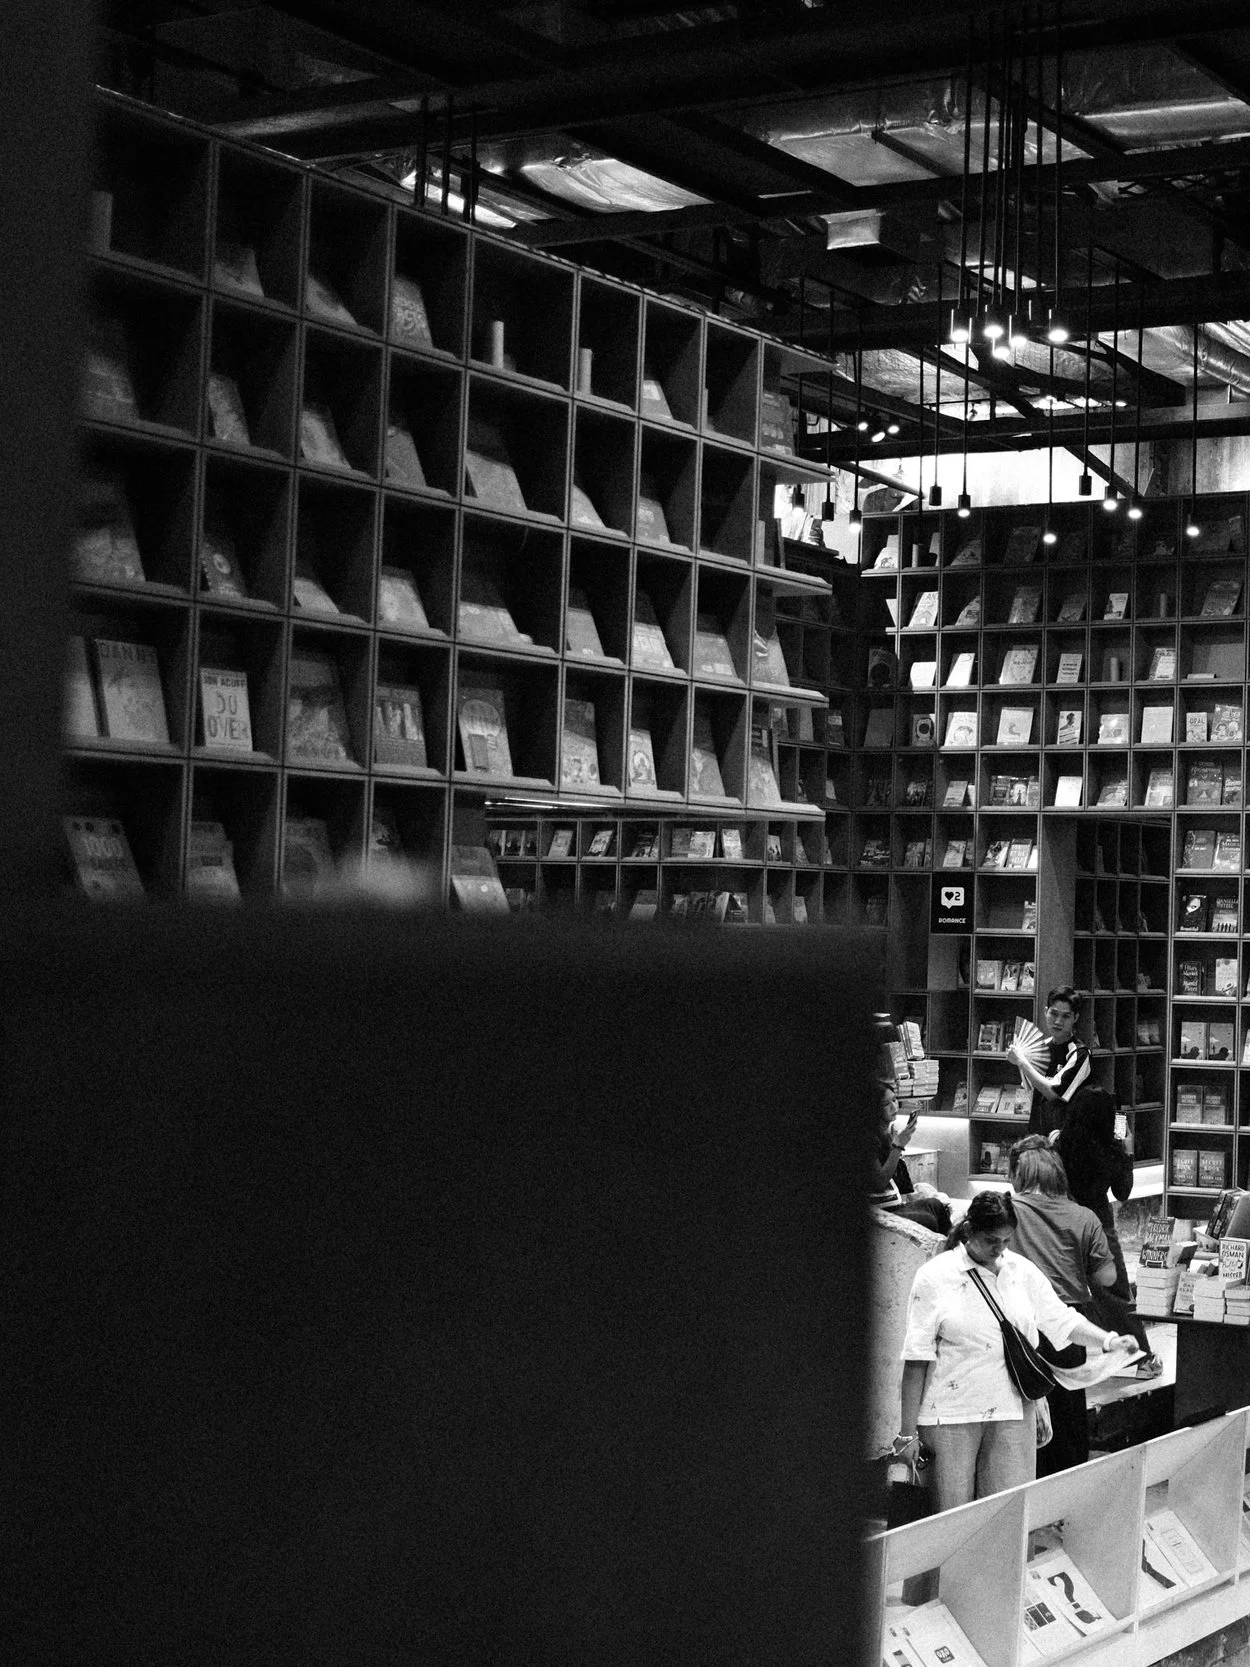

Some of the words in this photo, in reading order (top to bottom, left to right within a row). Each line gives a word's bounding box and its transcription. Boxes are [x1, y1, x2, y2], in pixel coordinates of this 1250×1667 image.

[954, 891, 961, 901] 2
[938, 917, 966, 925] ROMANCE
[1222, 1243, 1245, 1252] RICHARD
